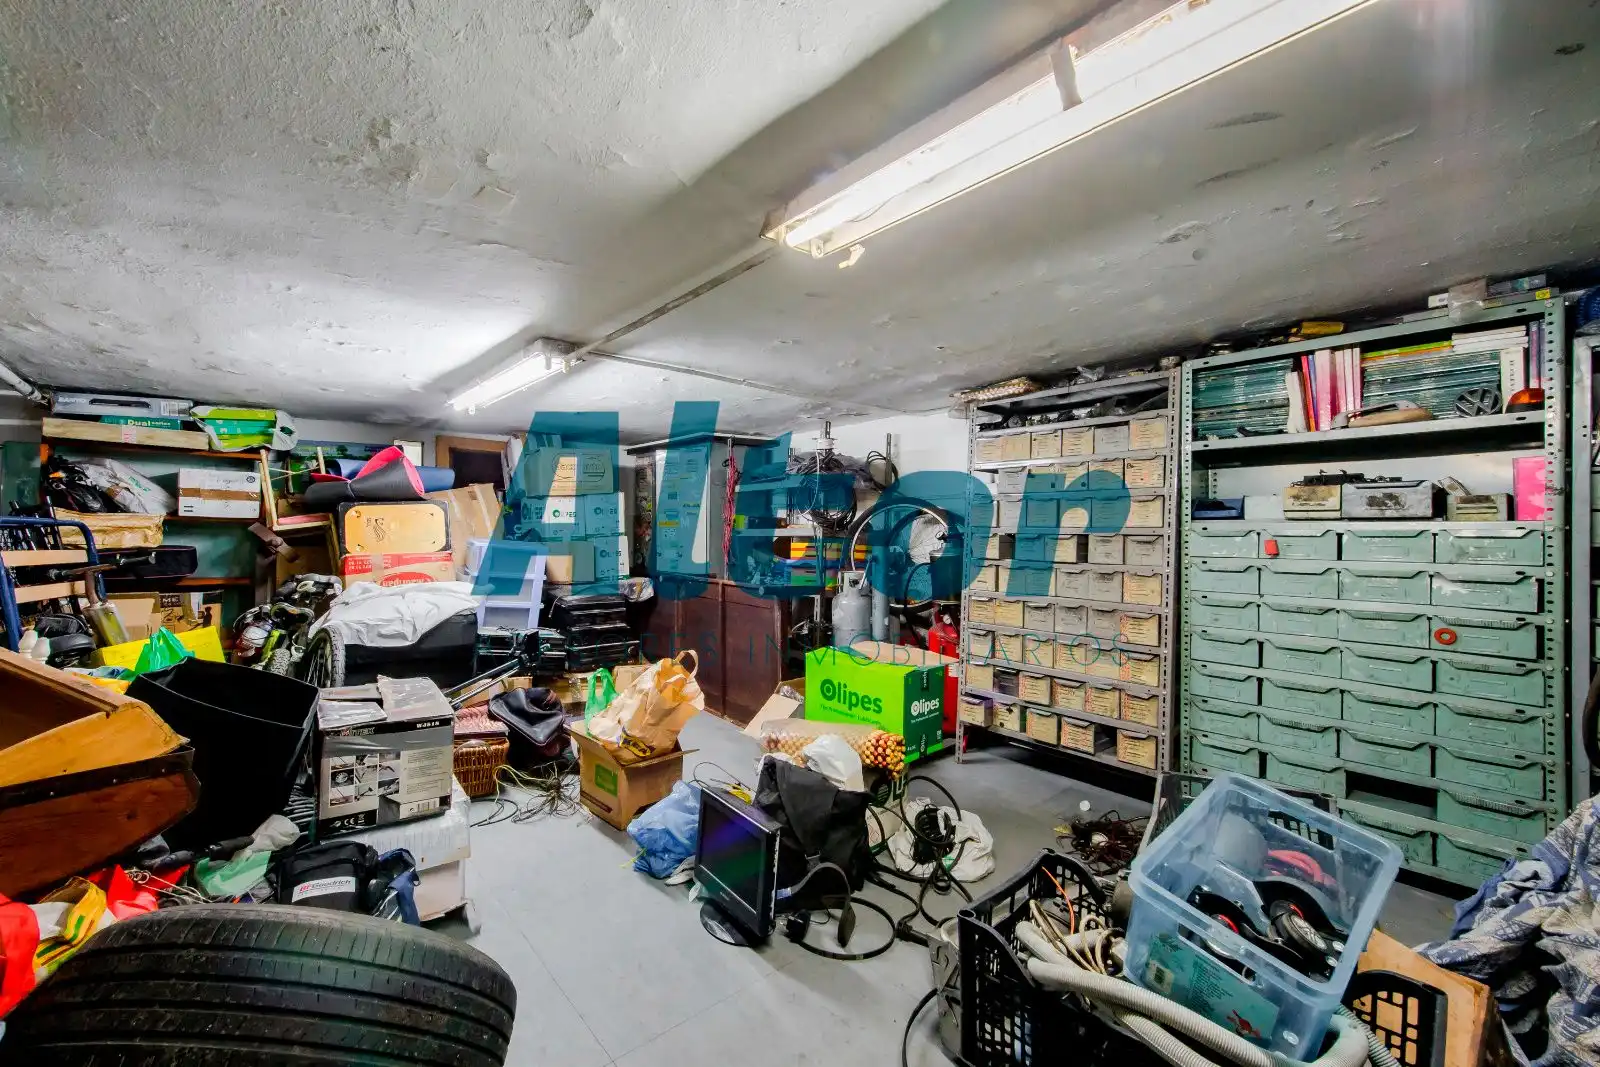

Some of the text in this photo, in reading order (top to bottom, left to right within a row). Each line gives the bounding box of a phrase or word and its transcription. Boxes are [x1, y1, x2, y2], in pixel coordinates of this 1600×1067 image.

[127, 419, 151, 428] Dual
[820, 678, 883, 714] Olipes
[910, 697, 940, 717] Olipes
